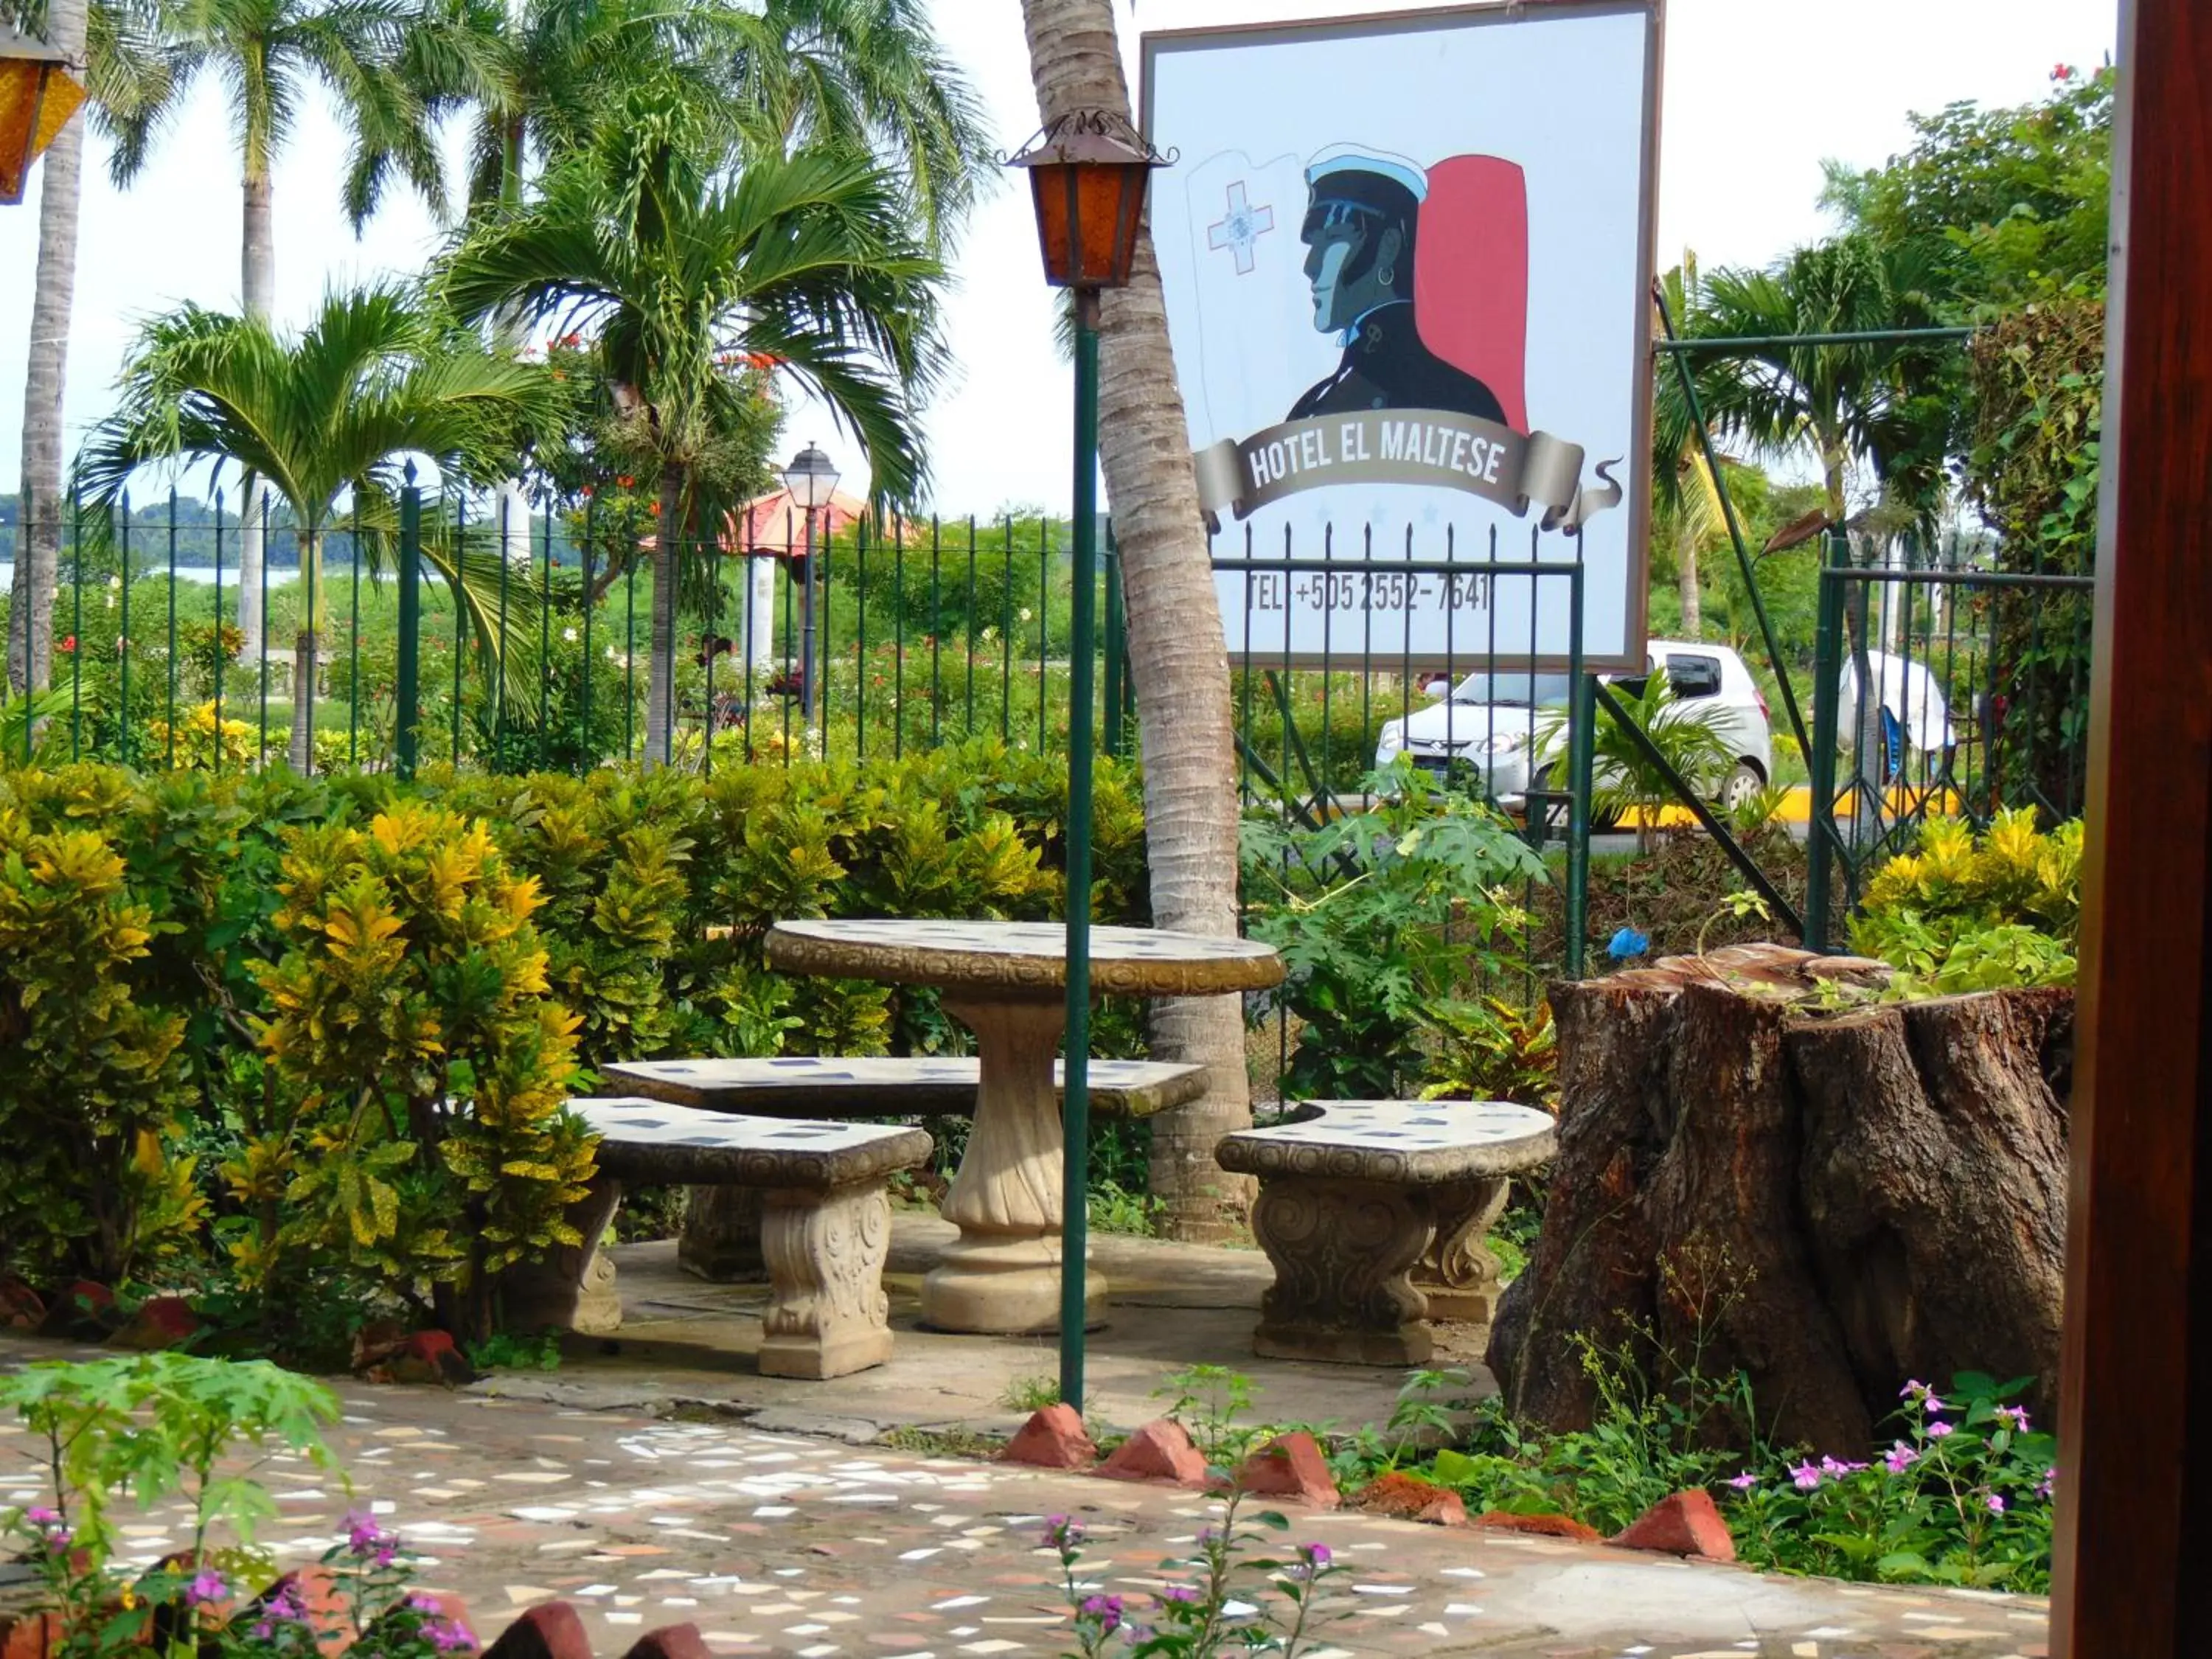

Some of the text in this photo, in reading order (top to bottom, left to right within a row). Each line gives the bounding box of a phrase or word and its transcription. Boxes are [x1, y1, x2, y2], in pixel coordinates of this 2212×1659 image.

[1249, 420, 1506, 489] HOTEL EL MALTESE
[1296, 574, 1353, 611] +505
